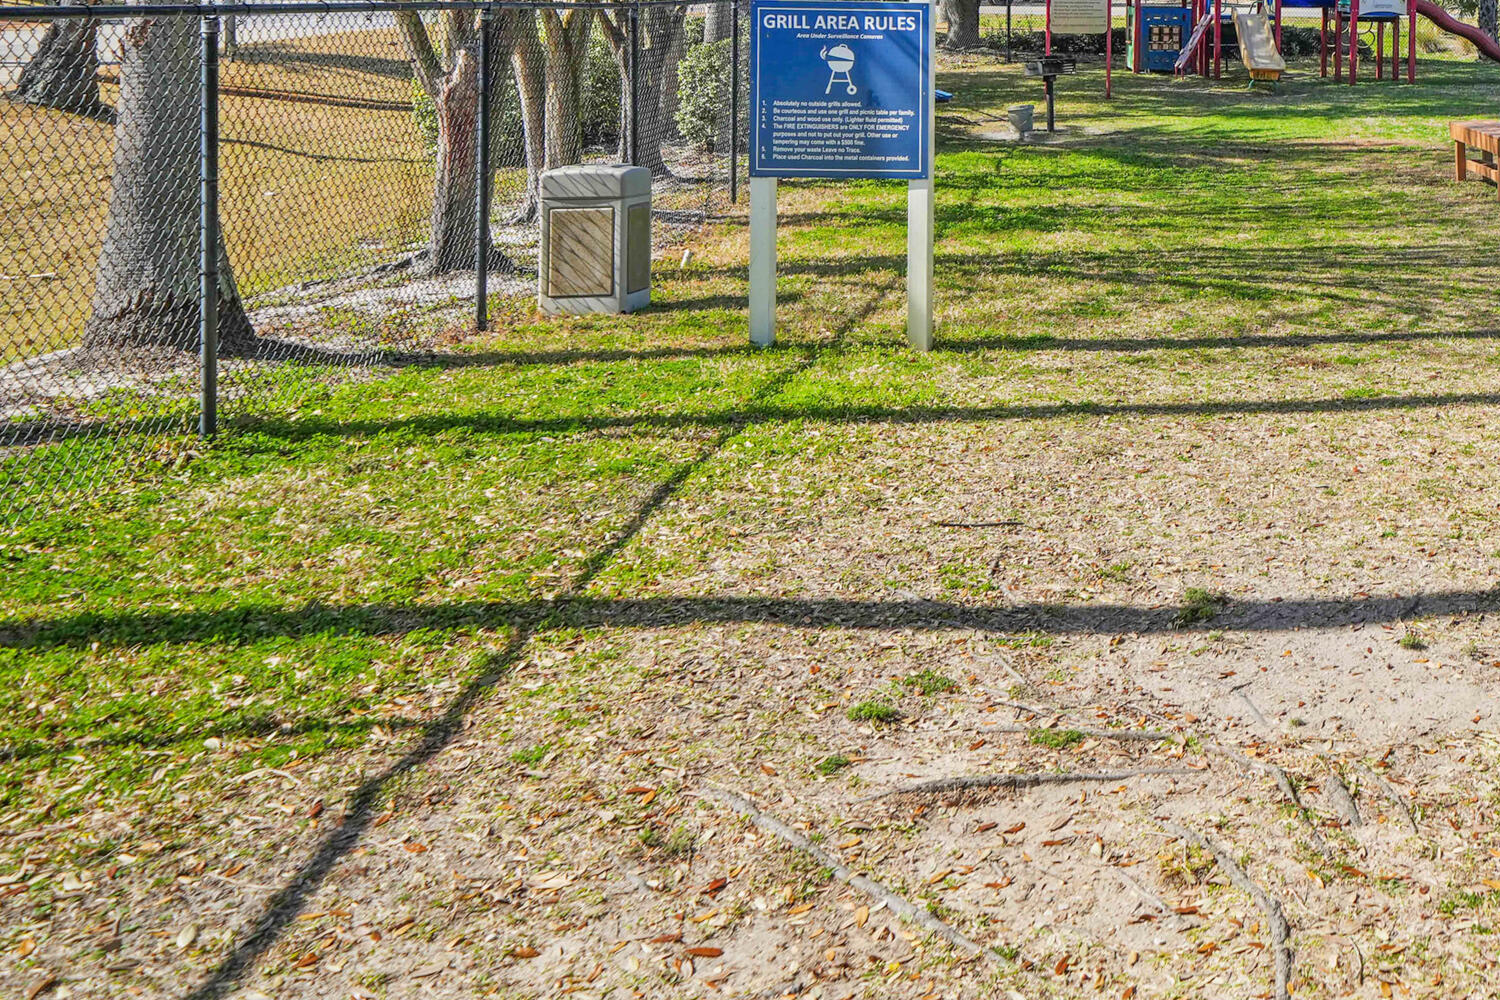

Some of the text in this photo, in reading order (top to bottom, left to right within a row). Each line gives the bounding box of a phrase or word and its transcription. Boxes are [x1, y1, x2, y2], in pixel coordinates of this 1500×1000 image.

[763, 14, 916, 31] GRILL AREA RULES
